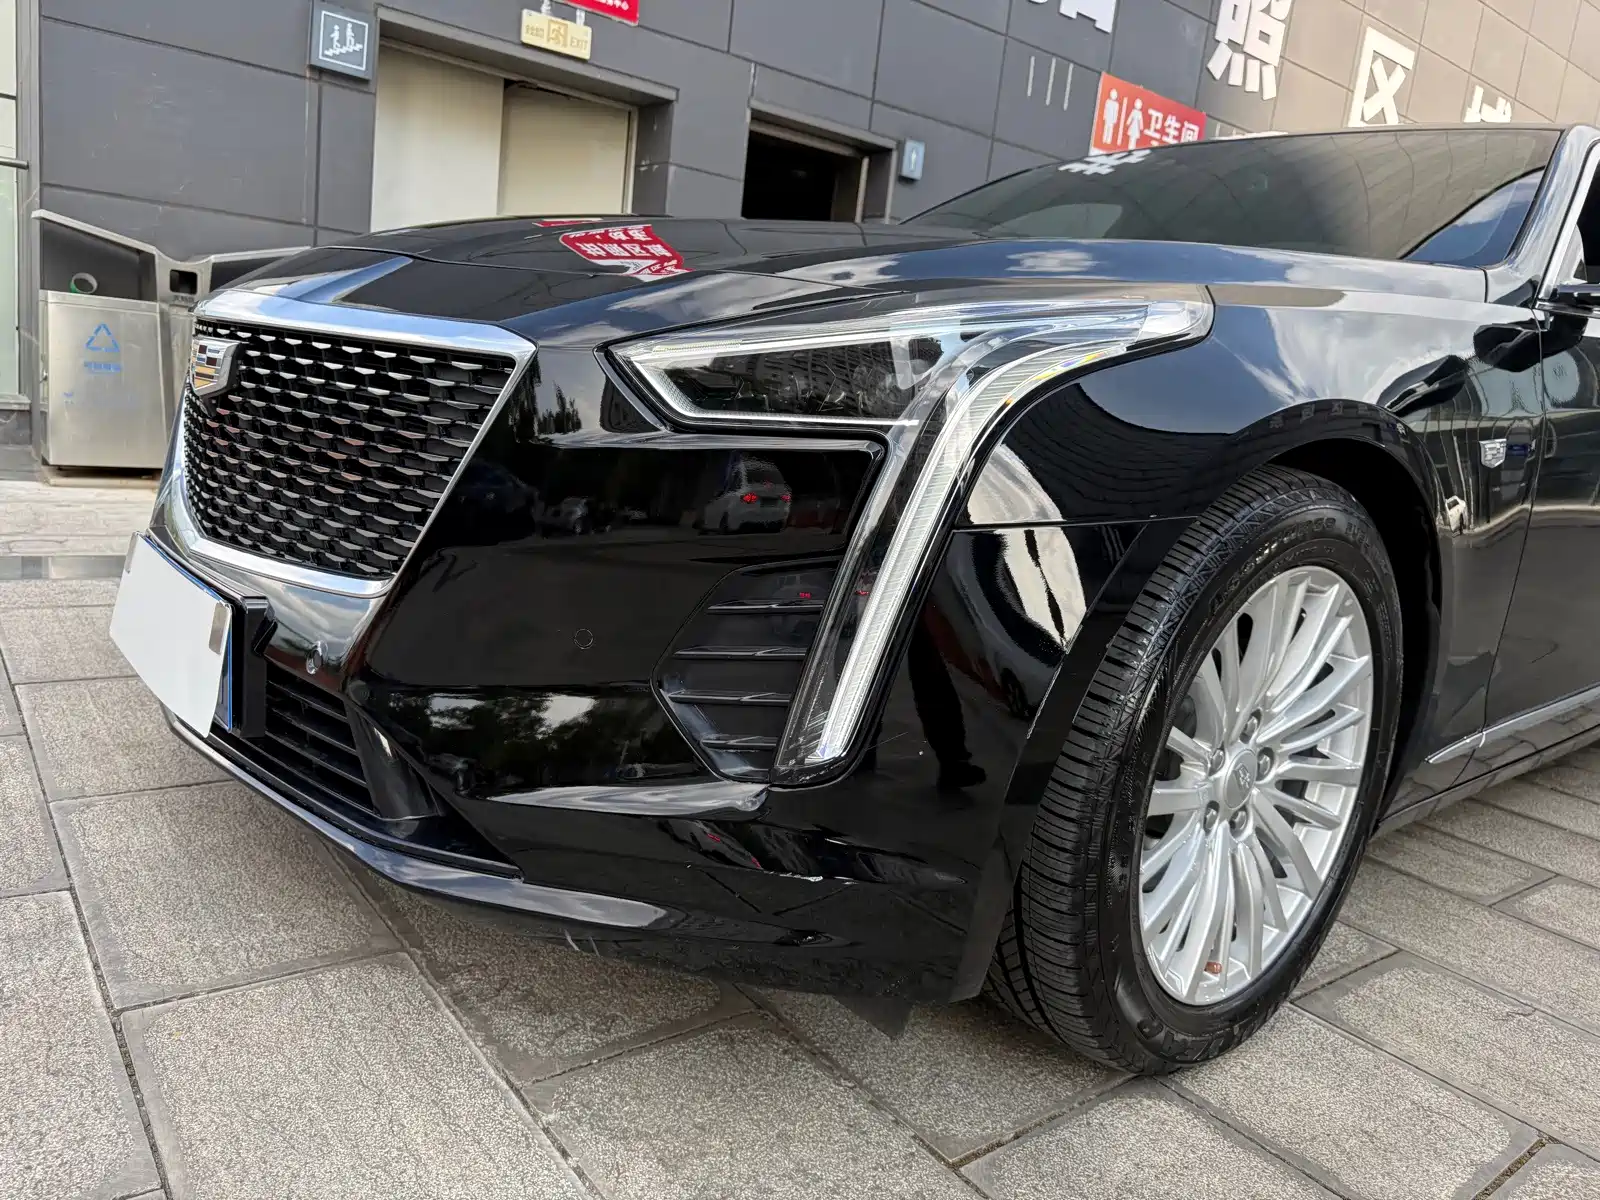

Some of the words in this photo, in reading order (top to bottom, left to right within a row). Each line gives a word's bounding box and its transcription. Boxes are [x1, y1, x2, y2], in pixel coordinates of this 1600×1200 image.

[570, 36, 588, 51] EXIT
[1144, 107, 1200, 145] 卫生间
